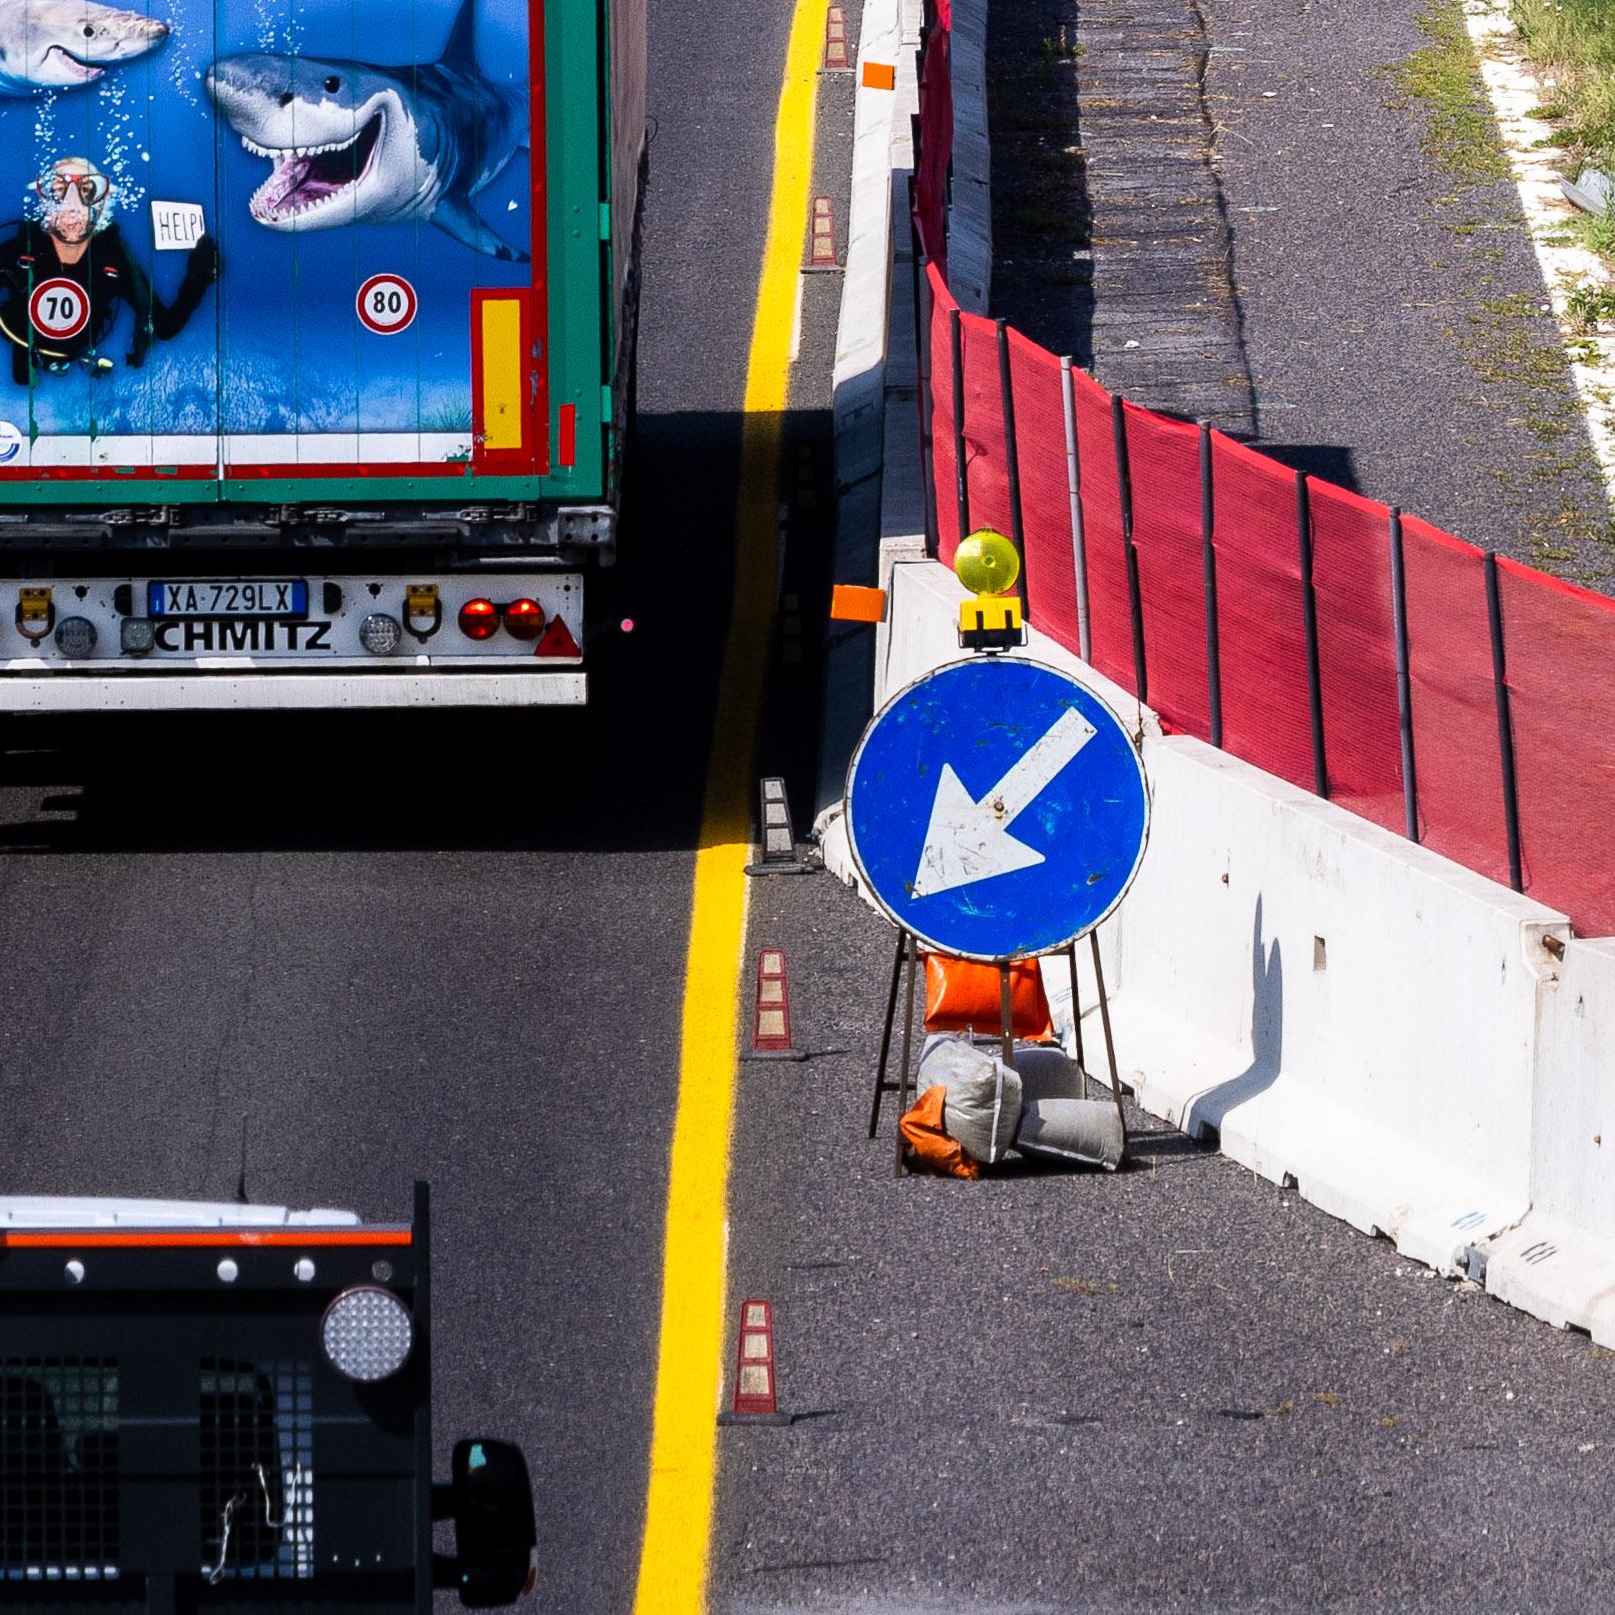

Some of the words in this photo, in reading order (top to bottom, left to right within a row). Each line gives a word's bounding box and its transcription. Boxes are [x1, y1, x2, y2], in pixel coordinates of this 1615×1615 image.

[159, 211, 204, 242] HELP!
[46, 296, 74, 320] 70
[373, 291, 401, 313] 80
